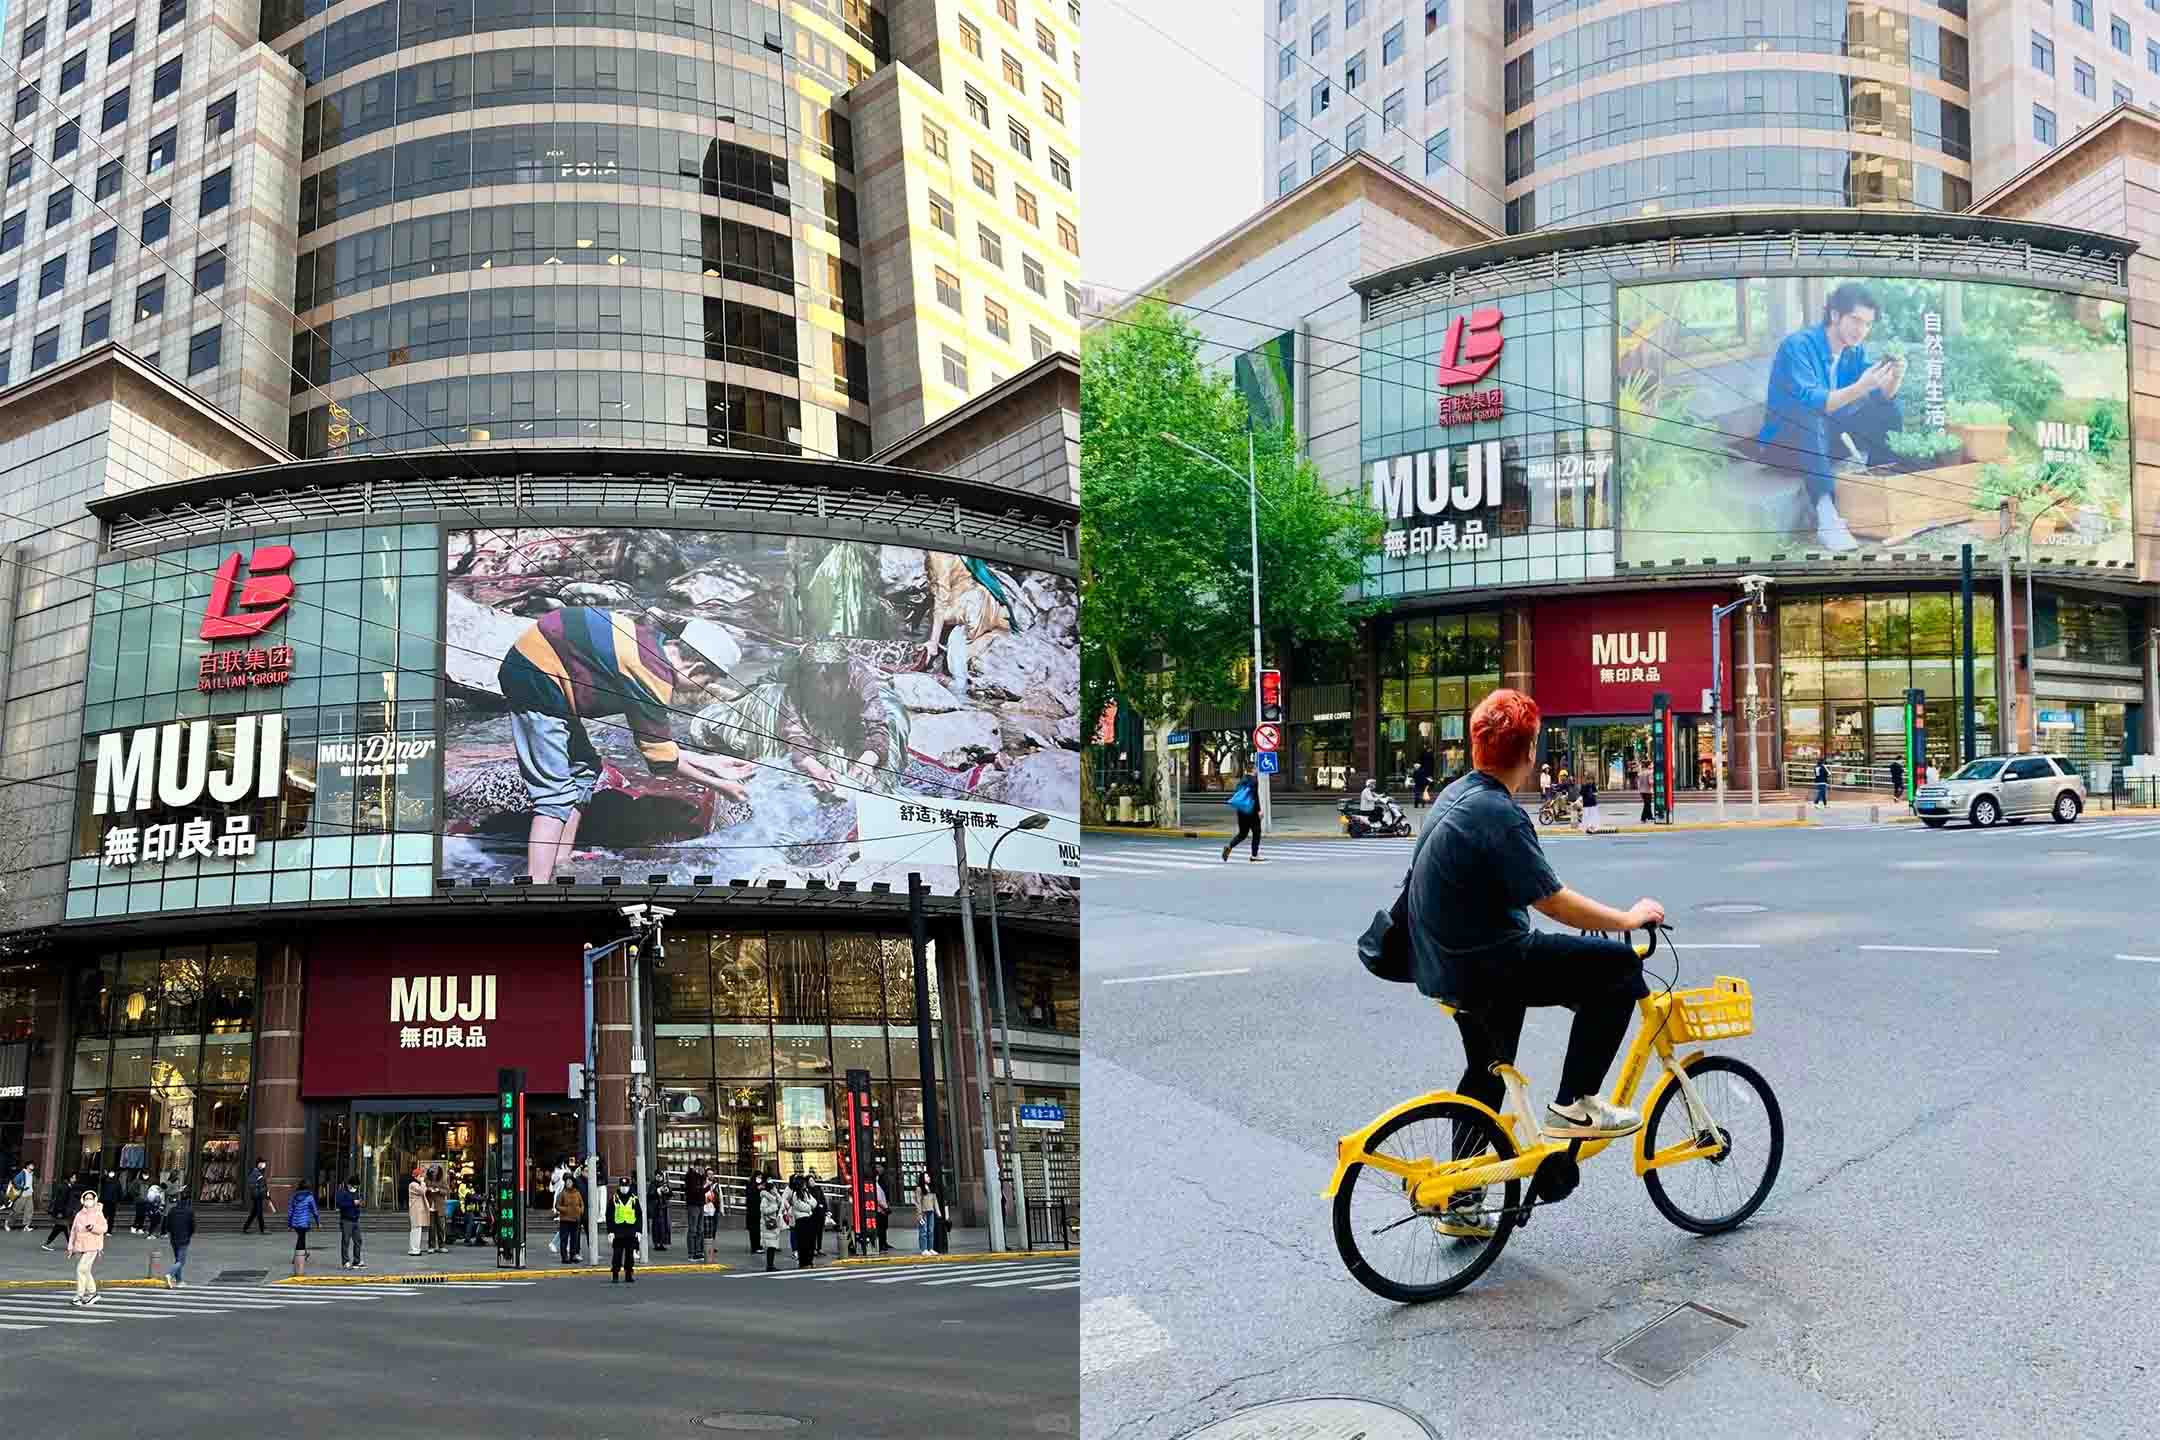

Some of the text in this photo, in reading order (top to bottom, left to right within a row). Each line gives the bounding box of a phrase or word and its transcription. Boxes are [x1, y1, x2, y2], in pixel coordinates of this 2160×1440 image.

[1440, 388, 1504, 413] 百联集团
[2036, 421, 2089, 450] MUJI
[1373, 440, 1503, 519] MUJI
[1384, 519, 1489, 559] 無印良品
[199, 645, 291, 674] 百联集团
[1592, 631, 1667, 665] MUJI
[198, 671, 289, 690] BAILIAN GROUP
[1600, 667, 1661, 683] 無印良品
[320, 734, 436, 763] MUJI Diner
[93, 713, 284, 816] MUJI
[104, 815, 257, 867] 無印良品
[390, 974, 497, 1022] MUJI
[400, 1025, 487, 1049] 無印良品
